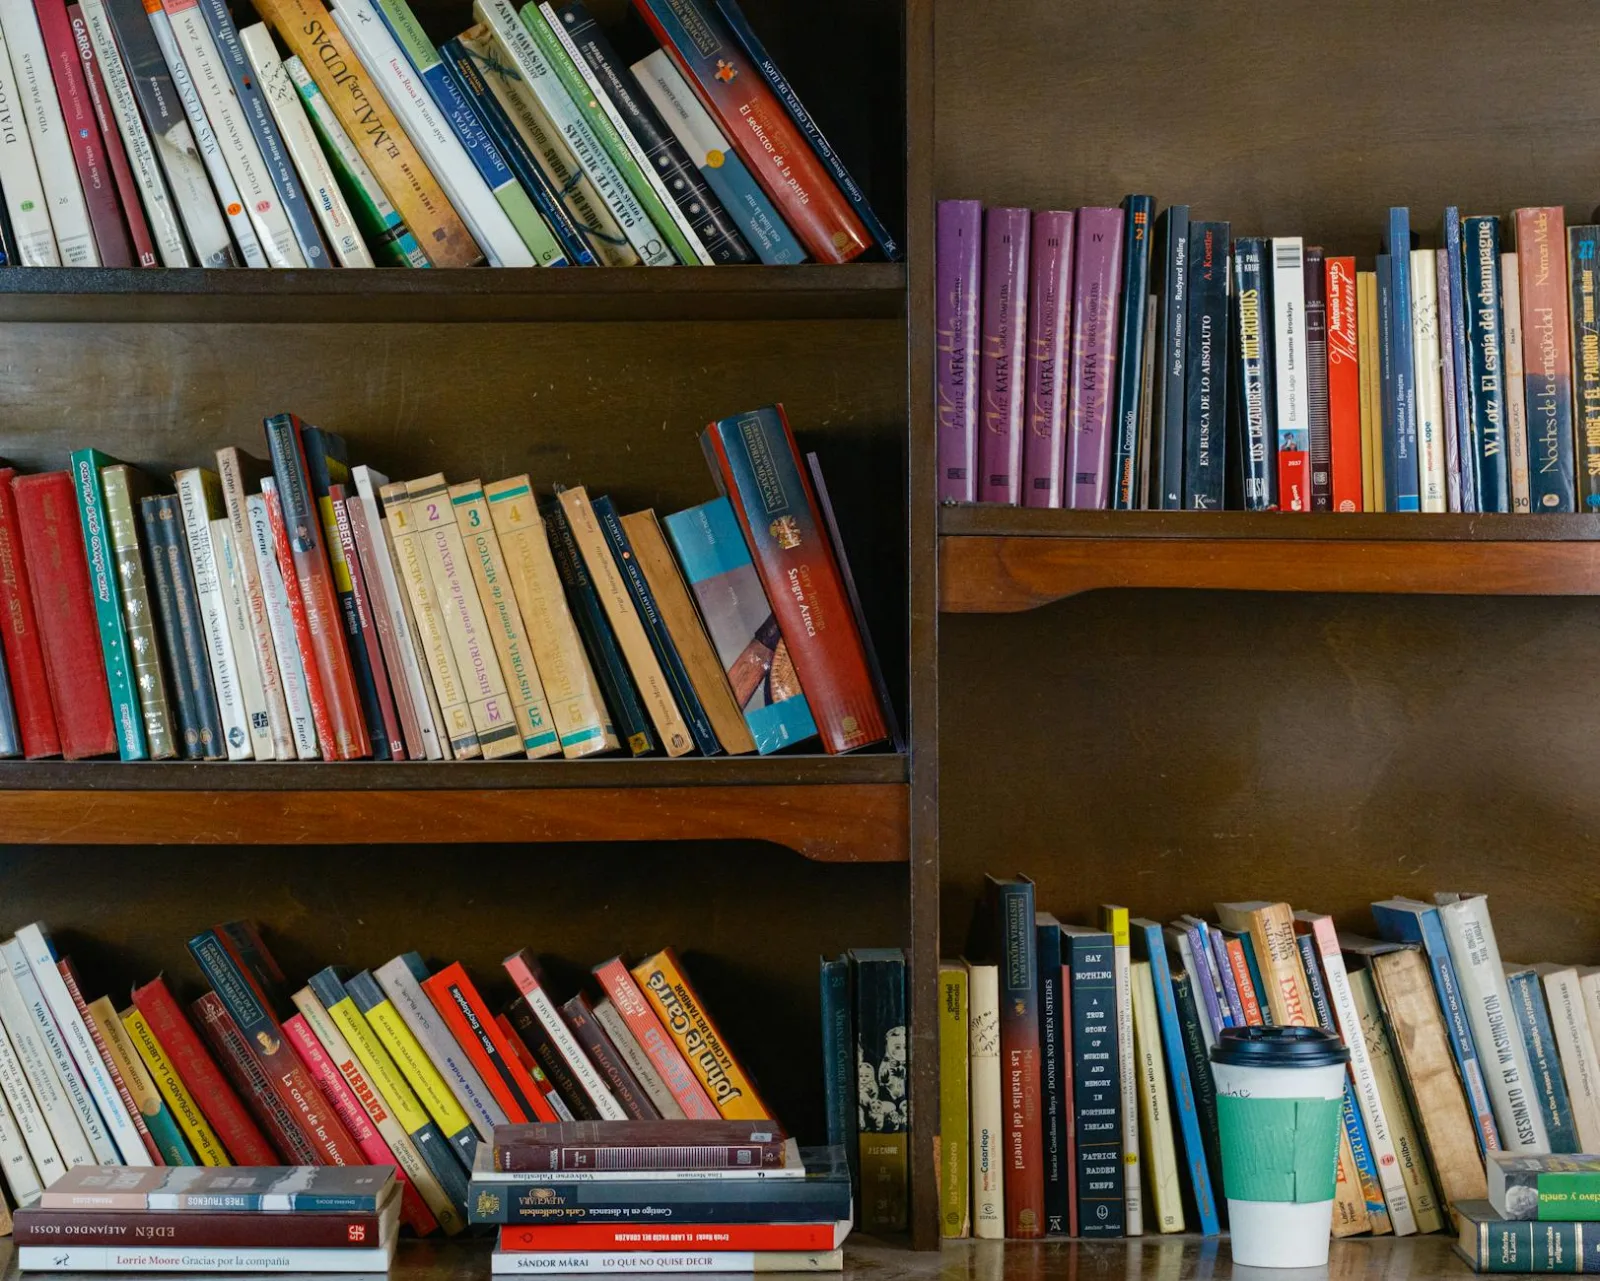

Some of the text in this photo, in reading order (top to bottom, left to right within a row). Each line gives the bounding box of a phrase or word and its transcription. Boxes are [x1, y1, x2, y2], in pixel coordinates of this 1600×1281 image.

[183, 17, 262, 195] EUGENIA GRANDET LA PIEL DE ZAPA
[301, 16, 400, 158] EL MAL DE JUDAS
[388, 57, 448, 146] Isaac Rosa El vano ayer
[738, 103, 811, 207] El seductor de la patria
[760, 58, 862, 203] Cristina Rivera Garza LA CRESTA DE ILIÓN
[1136, 229, 1143, 239] 2
[1203, 229, 1213, 279] A. Koestler
[1533, 212, 1549, 285] Norman Mailer
[1172, 236, 1186, 375] Algo de mí mismo Rudyard Kipling
[1238, 288, 1260, 359] MICROBIOS
[1328, 265, 1340, 329] Antonio Larreta
[1200, 314, 1212, 465] EN BUSCA DE LO ABSOLUTO
[1246, 363, 1260, 376] DE
[1284, 301, 1296, 421] Eduardo Lago Llámame Brooklyn
[1534, 307, 1559, 472] Noches de la antigüedad
[1246, 381, 1263, 436] CAZADORES
[742, 424, 777, 509] HISTORIA MEXICANA
[1250, 442, 1264, 461] LOS
[393, 510, 408, 528] 1
[426, 504, 440, 522] 2
[468, 510, 480, 528] 3
[298, 575, 322, 636] Javier Mina
[400, 535, 457, 702] HISTORIA general de MEXICO
[433, 528, 492, 695] HISTORIA general de MEXICO
[474, 534, 534, 701] HISTORIA general de MEXICO
[785, 566, 819, 637] Sangre Azteca
[208, 606, 234, 706] GRAHAM GREENE
[1008, 898, 1019, 985] HISTORIA MEXICANA
[1076, 971, 1112, 980] NOTHING
[1085, 955, 1102, 963] SAY
[199, 946, 252, 1024] HISTORIA MEXICANA
[1231, 948, 1258, 1017] de gobernar
[449, 986, 495, 1054] Blom Encyclopédie
[641, 966, 742, 1107] John le Carré
[672, 982, 732, 1070] LA CHICA DEL TAMBOR
[1518, 977, 1561, 1127] John Dos Passos LA PRIMERA CATASTROFE
[134, 1019, 210, 1149] Beer DISEÑANDO LA LIBERTAD
[1084, 1052, 1110, 1060] MURDER
[1084, 1080, 1111, 1088] MEMORY
[1482, 993, 1536, 1147] ASESINATO EN WASHINGTON
[281, 1072, 348, 1170] La corte de los ilusos
[1010, 1050, 1025, 1169] Las batallas del general
[1081, 1108, 1116, 1116] NORTHERN
[1084, 1123, 1114, 1131] IRELAND
[1082, 1152, 1118, 1161] PATRICK
[1086, 1166, 1116, 1175] RADDEN
[1090, 1182, 1114, 1190] KEEFE
[29, 1224, 174, 1238] EDÉN ALEJANDRO ROSSI
[187, 1196, 244, 1205] TRES TRUENOS
[116, 1255, 290, 1267] Lorrie Moore Gracias por la compañía
[517, 1256, 713, 1267] SÁNDOR MÁRAI LO QUE NO QUISE DECIR
